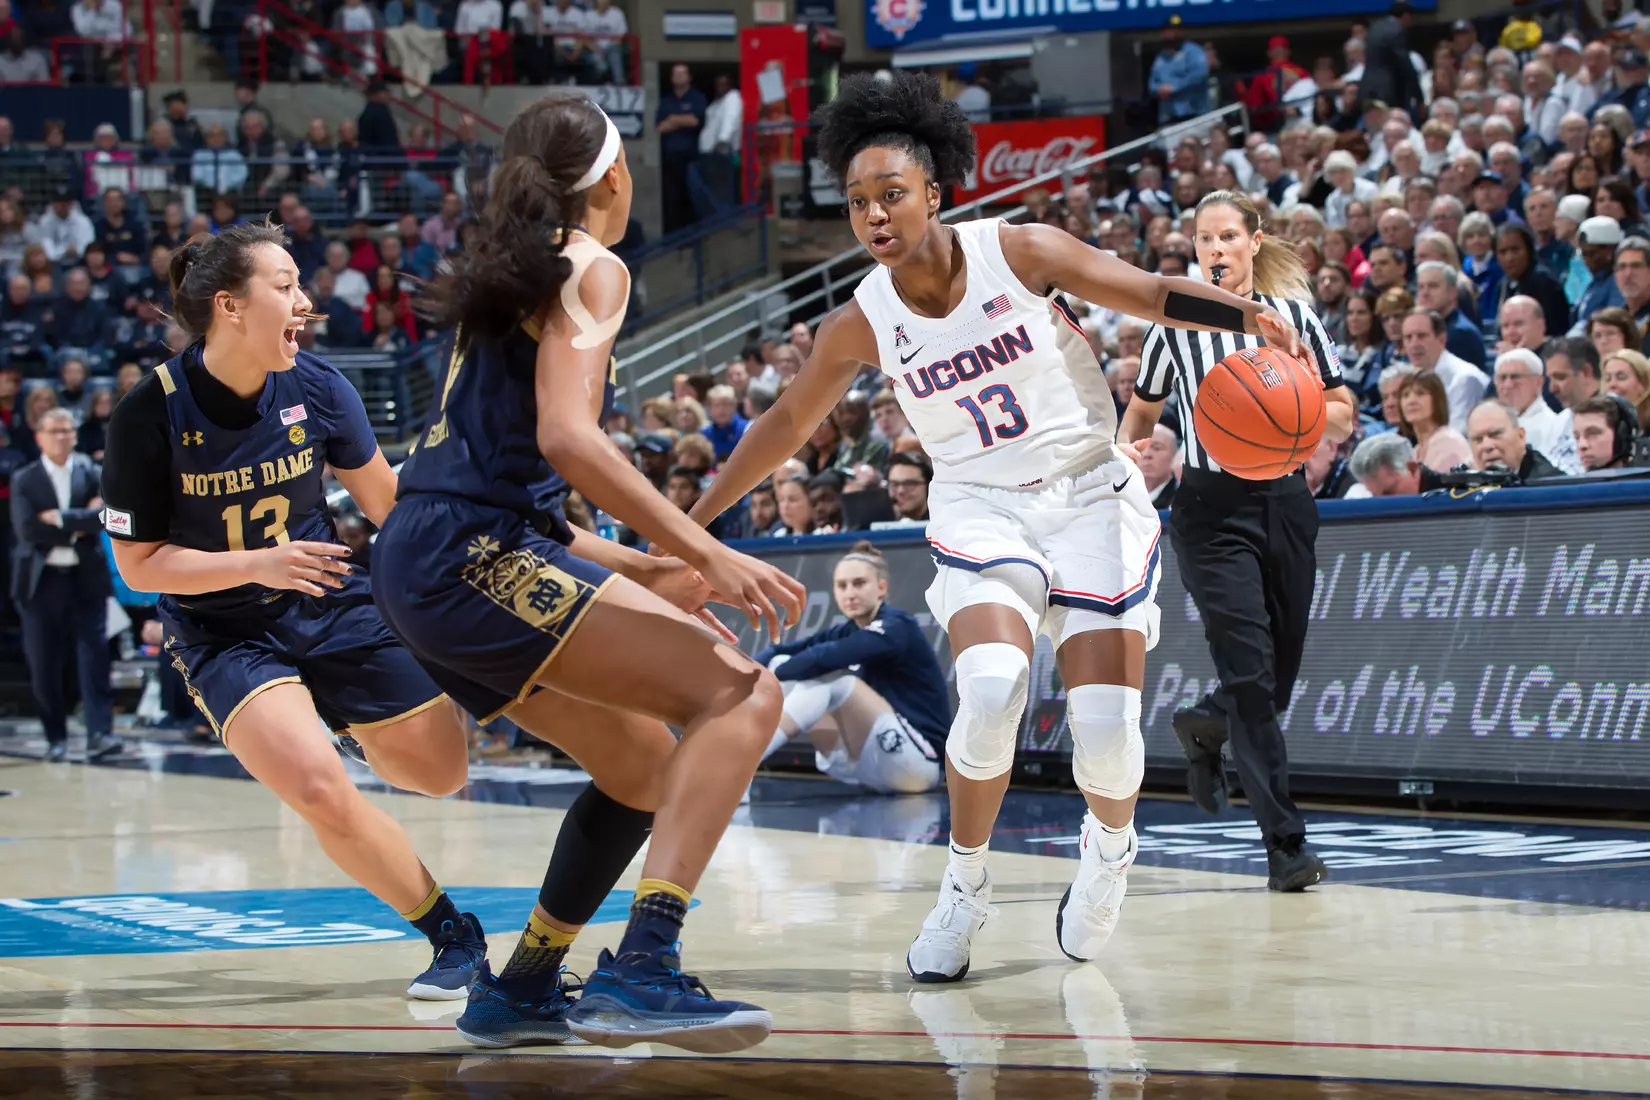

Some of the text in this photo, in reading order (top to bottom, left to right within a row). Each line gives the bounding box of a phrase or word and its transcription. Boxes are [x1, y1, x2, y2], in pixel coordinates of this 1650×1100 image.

[903, 324, 1034, 398] UCONN
[954, 383, 1029, 448] 13
[181, 447, 313, 497] NOTRE DAME
[222, 495, 290, 551] 13
[1353, 547, 1526, 620] Wealth
[1313, 664, 1375, 733] of
[1373, 665, 1456, 735] the
[1470, 664, 1650, 741] UConn
